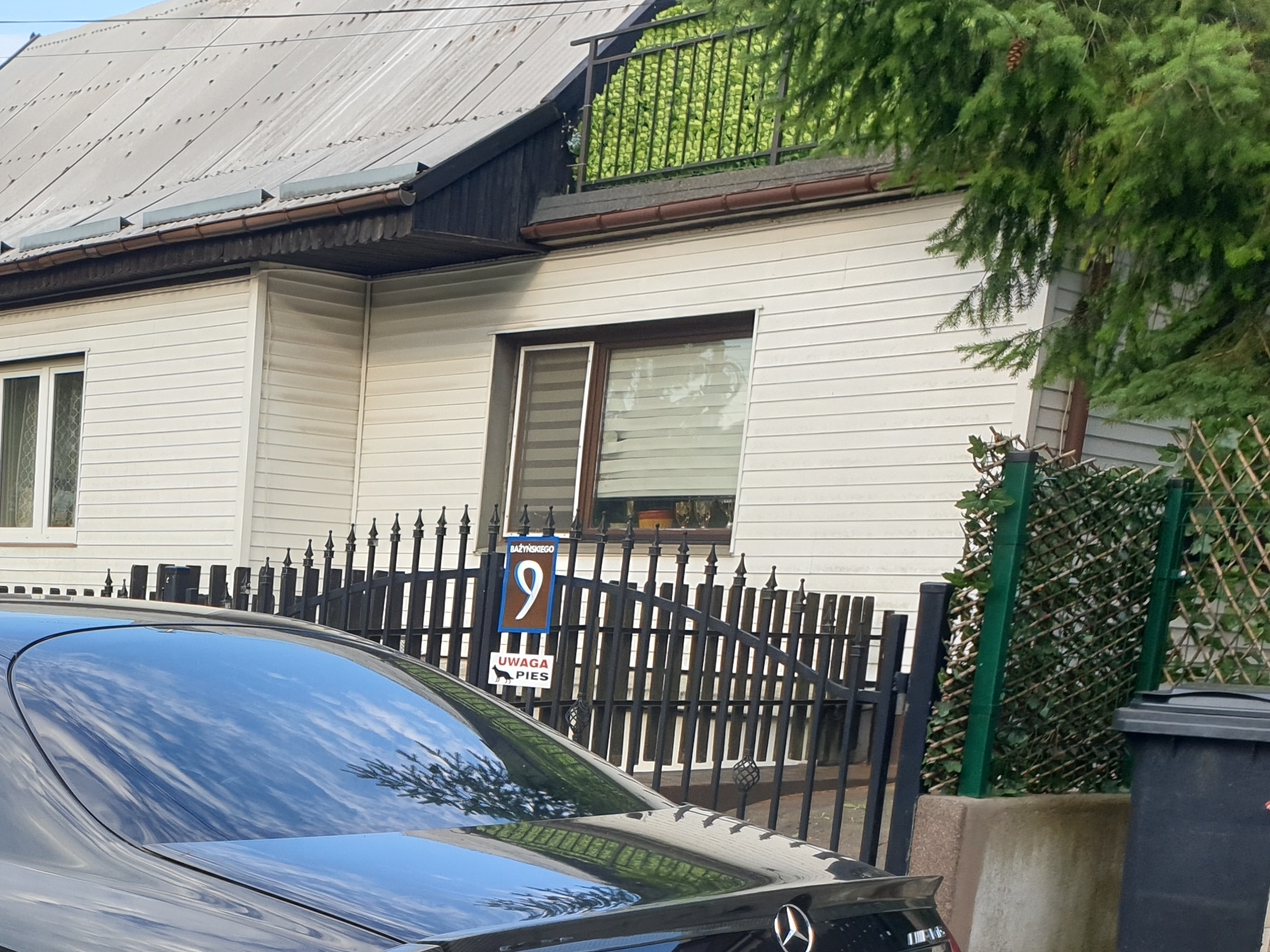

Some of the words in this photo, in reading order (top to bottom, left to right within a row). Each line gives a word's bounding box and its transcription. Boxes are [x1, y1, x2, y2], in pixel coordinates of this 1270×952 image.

[514, 559, 544, 621] 9
[498, 656, 549, 669] UWAGA
[516, 670, 549, 682] PIES
